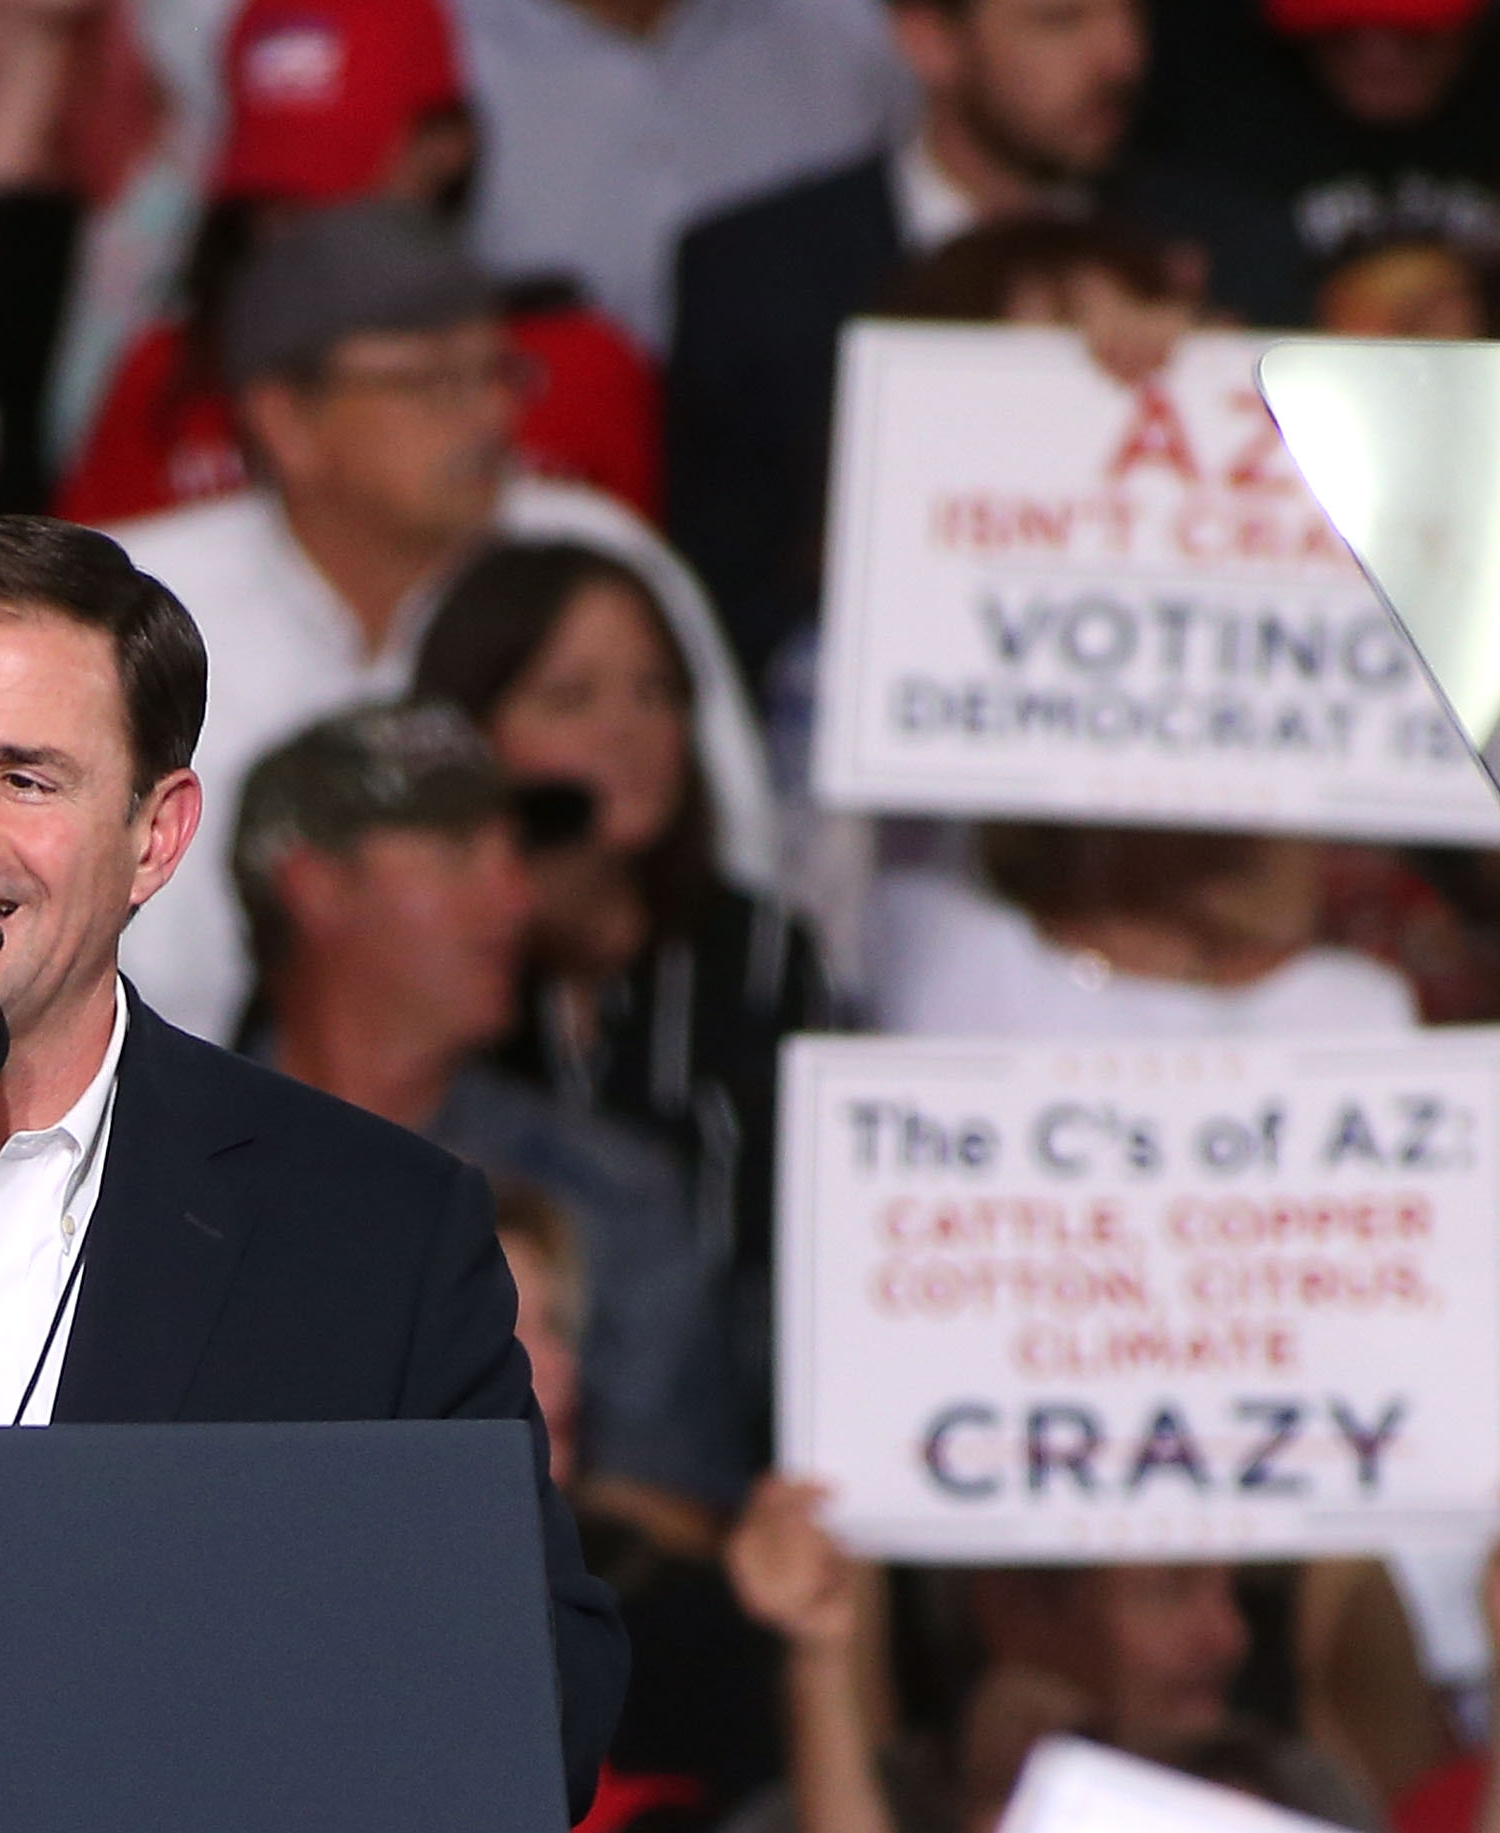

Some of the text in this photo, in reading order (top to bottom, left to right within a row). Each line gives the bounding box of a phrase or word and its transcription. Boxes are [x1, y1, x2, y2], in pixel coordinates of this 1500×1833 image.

[928, 490, 1134, 556] ISN'T
[974, 588, 1412, 692] VOTING
[888, 674, 1362, 758] DEMOCRAT
[848, 1098, 1000, 1174] The
[1026, 1098, 1164, 1178] C's
[1190, 1096, 1288, 1172] of
[1010, 1318, 1304, 1378] CLIMATE
[918, 1396, 1416, 1500] CRAZY
